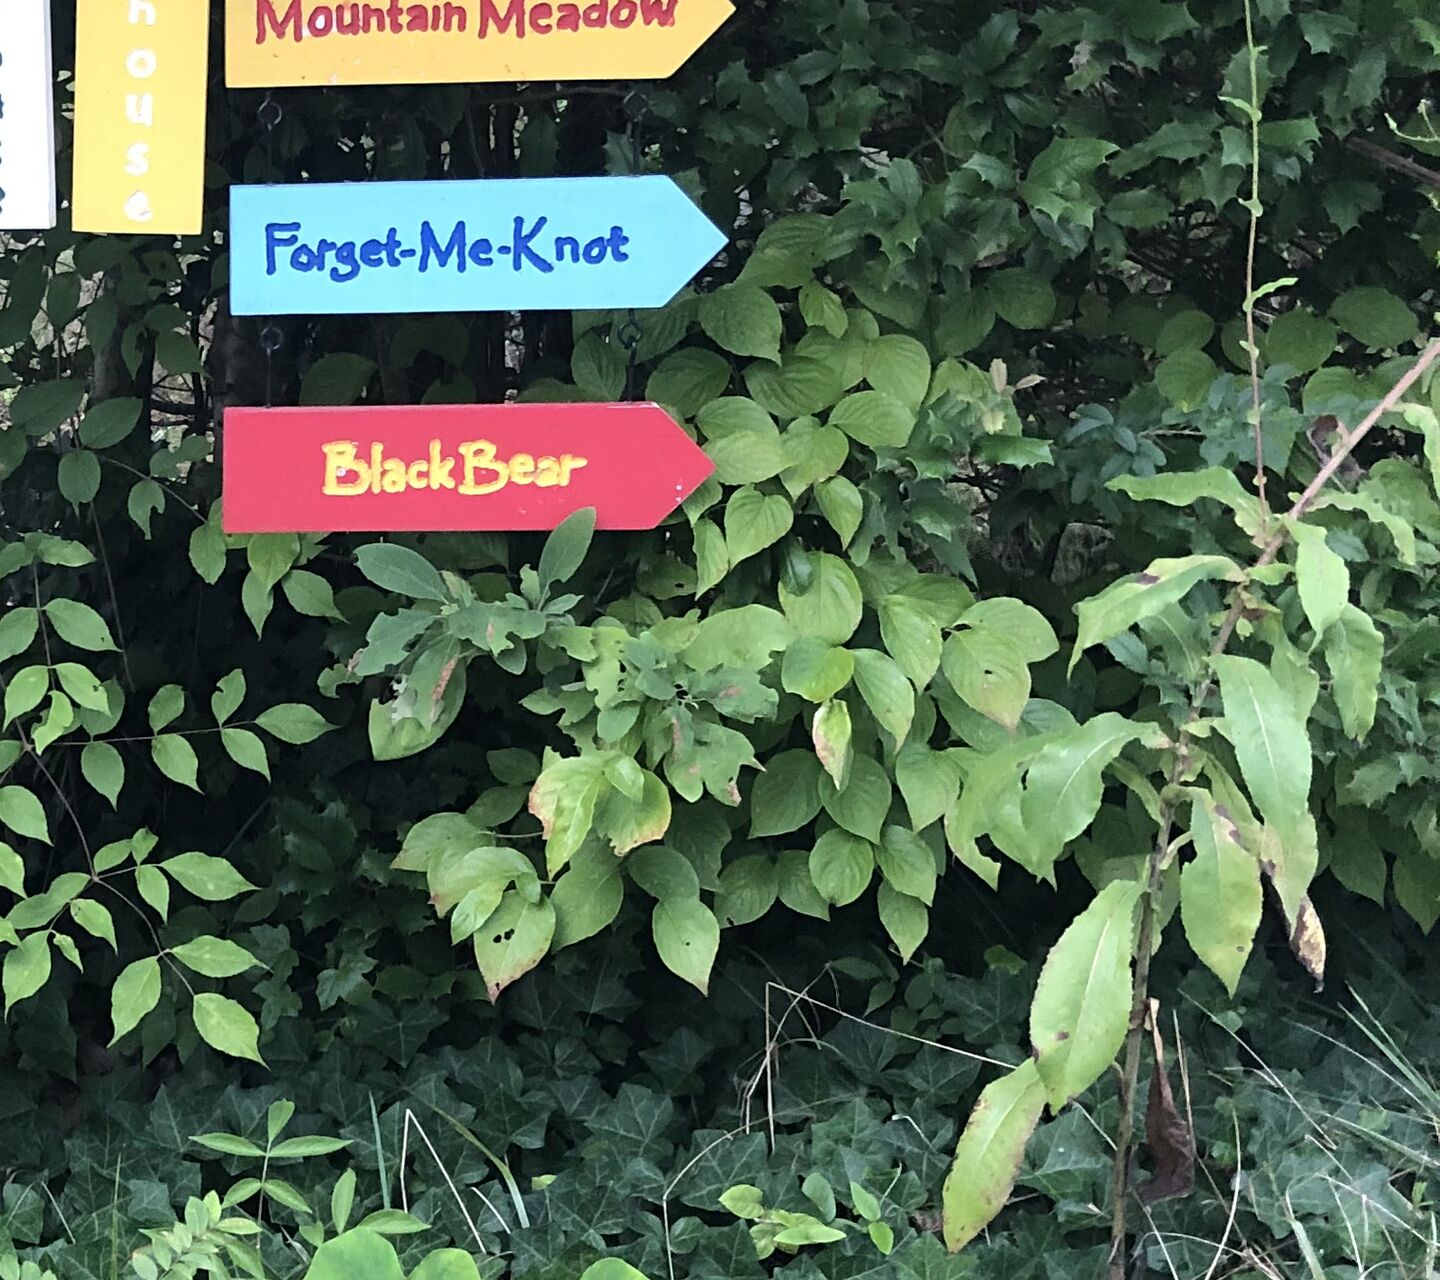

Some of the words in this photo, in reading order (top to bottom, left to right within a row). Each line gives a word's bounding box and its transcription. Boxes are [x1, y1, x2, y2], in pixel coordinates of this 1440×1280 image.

[264, 216, 630, 282] Forget-Me-Knot
[321, 438, 456, 496] Black
[457, 439, 588, 496] Bear
